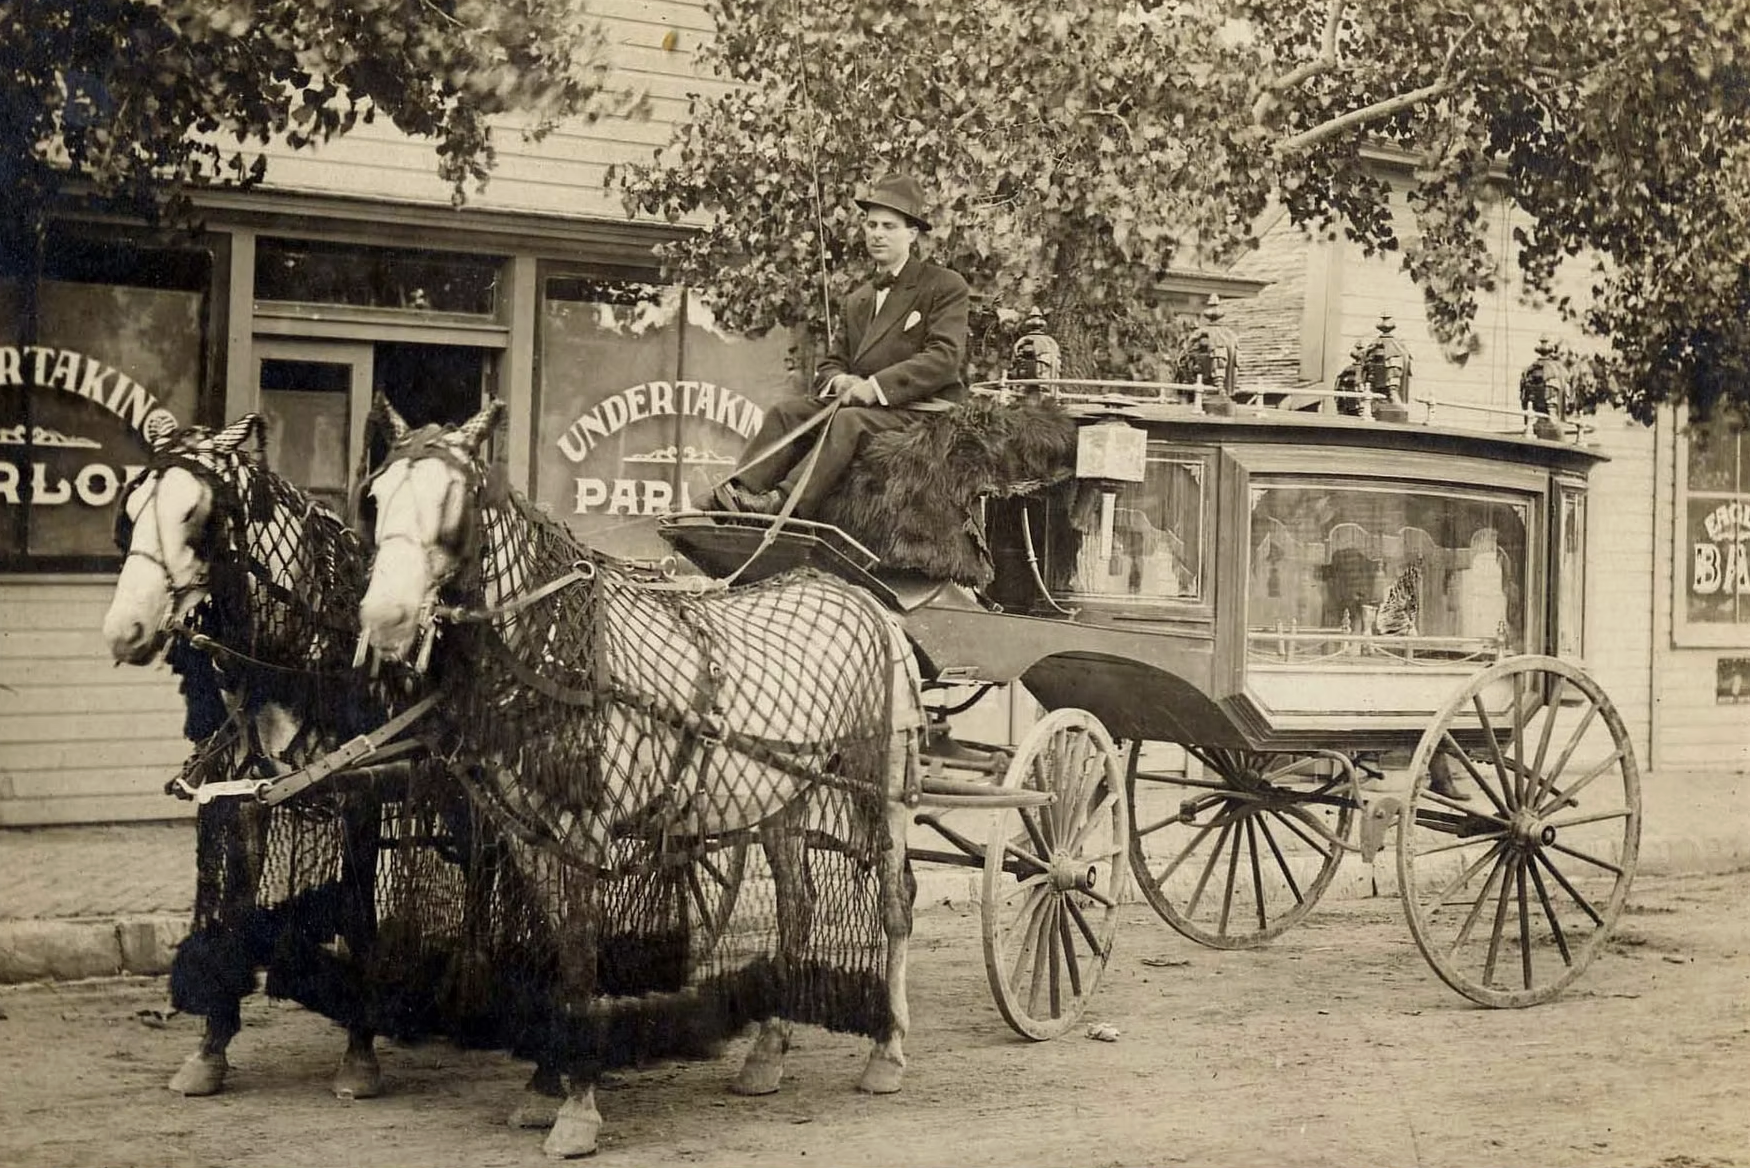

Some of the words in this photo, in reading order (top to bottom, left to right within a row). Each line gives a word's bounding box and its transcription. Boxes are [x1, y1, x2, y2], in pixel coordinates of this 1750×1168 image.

[0, 346, 157, 431] RTAKIN
[557, 381, 765, 462] UNDERTAKIN
[0, 462, 146, 506] RLO
